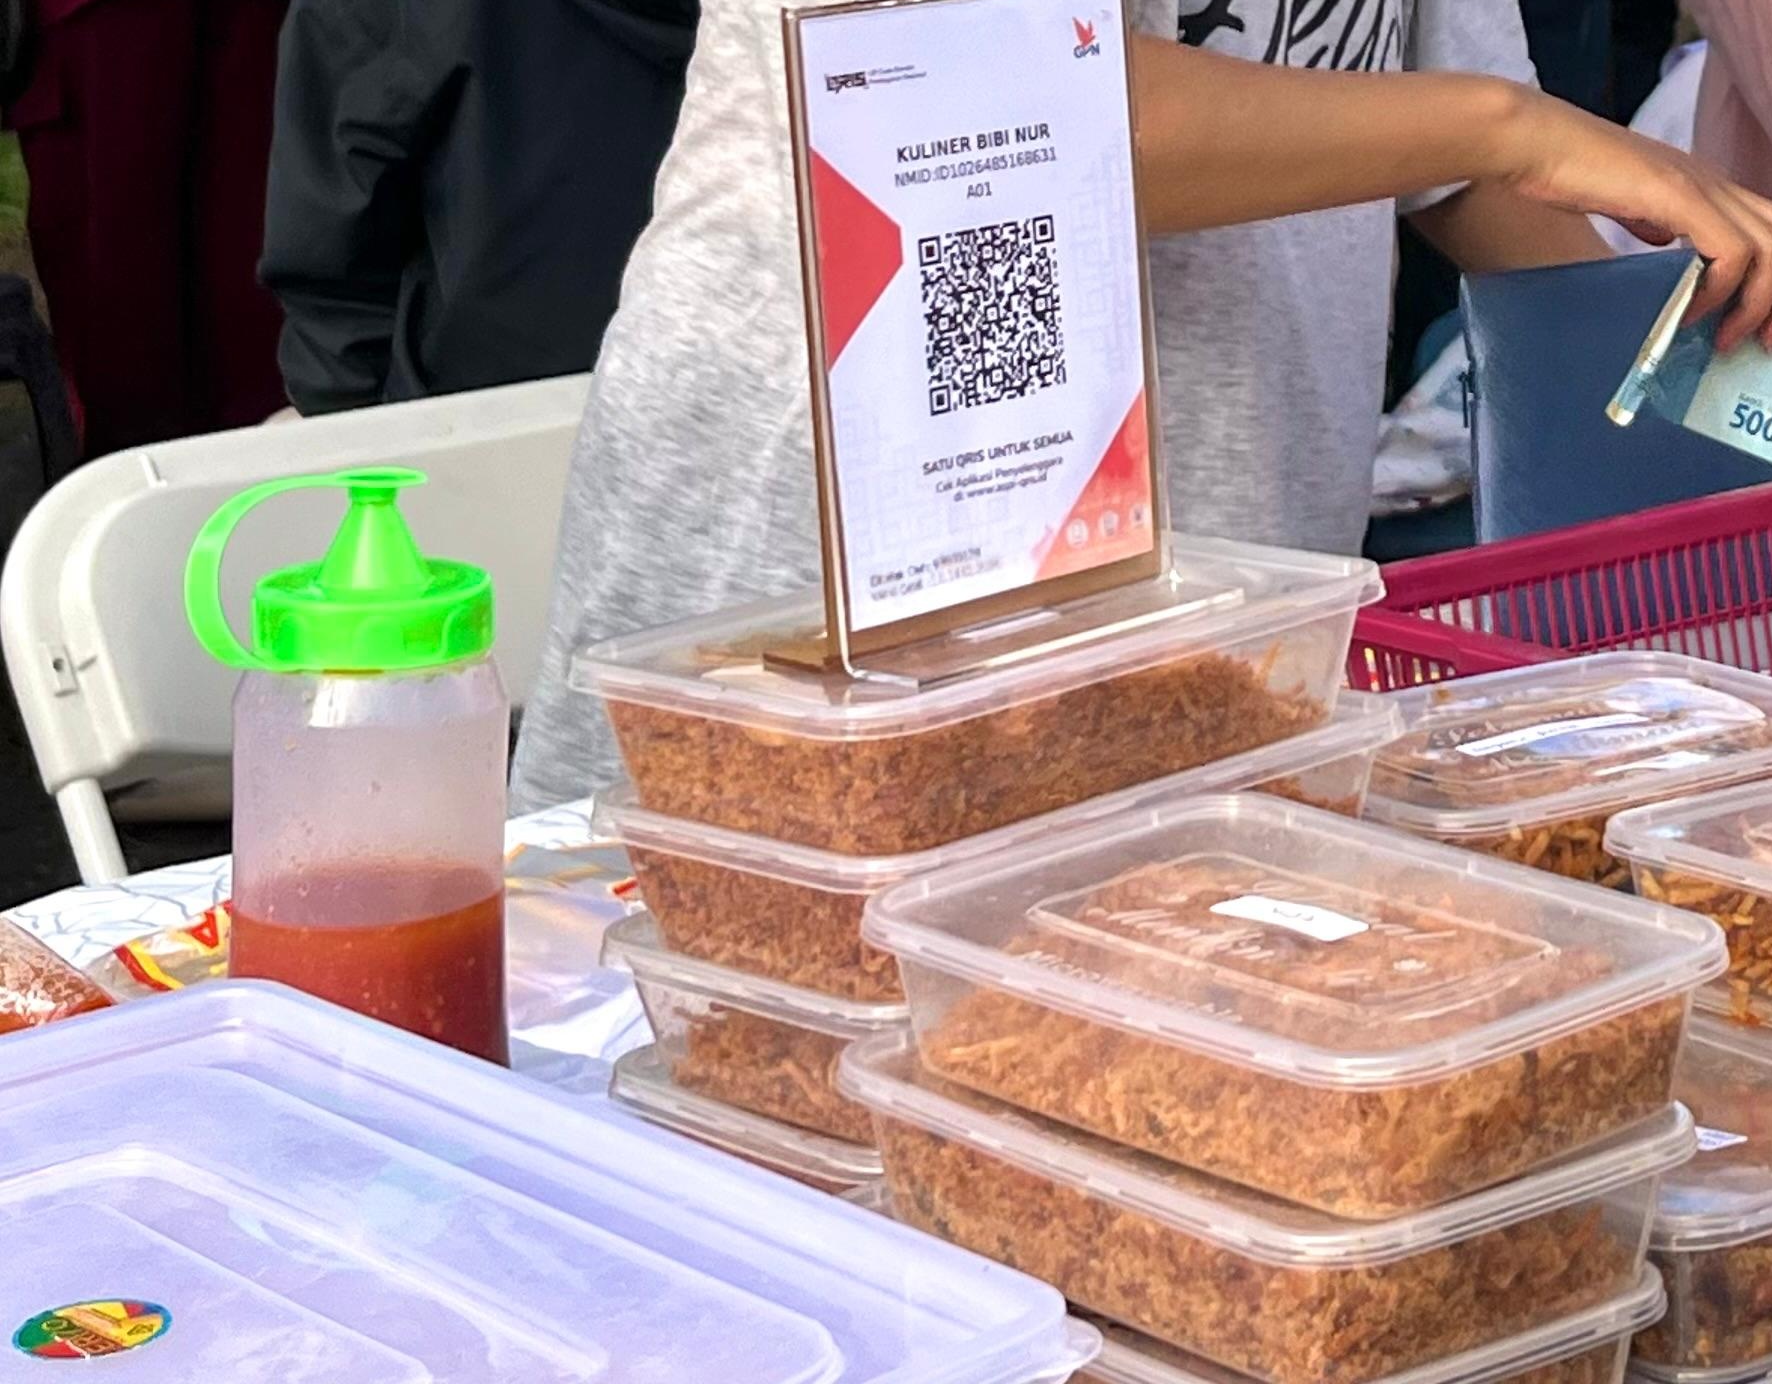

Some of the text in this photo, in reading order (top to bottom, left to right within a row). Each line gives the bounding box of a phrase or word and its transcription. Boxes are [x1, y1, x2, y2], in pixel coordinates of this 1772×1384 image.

[897, 123, 1050, 164] KULINER BIBI NUR
[966, 181, 992, 199] A01
[922, 430, 1074, 476] SATU QRIS UNTUK SEMUA
